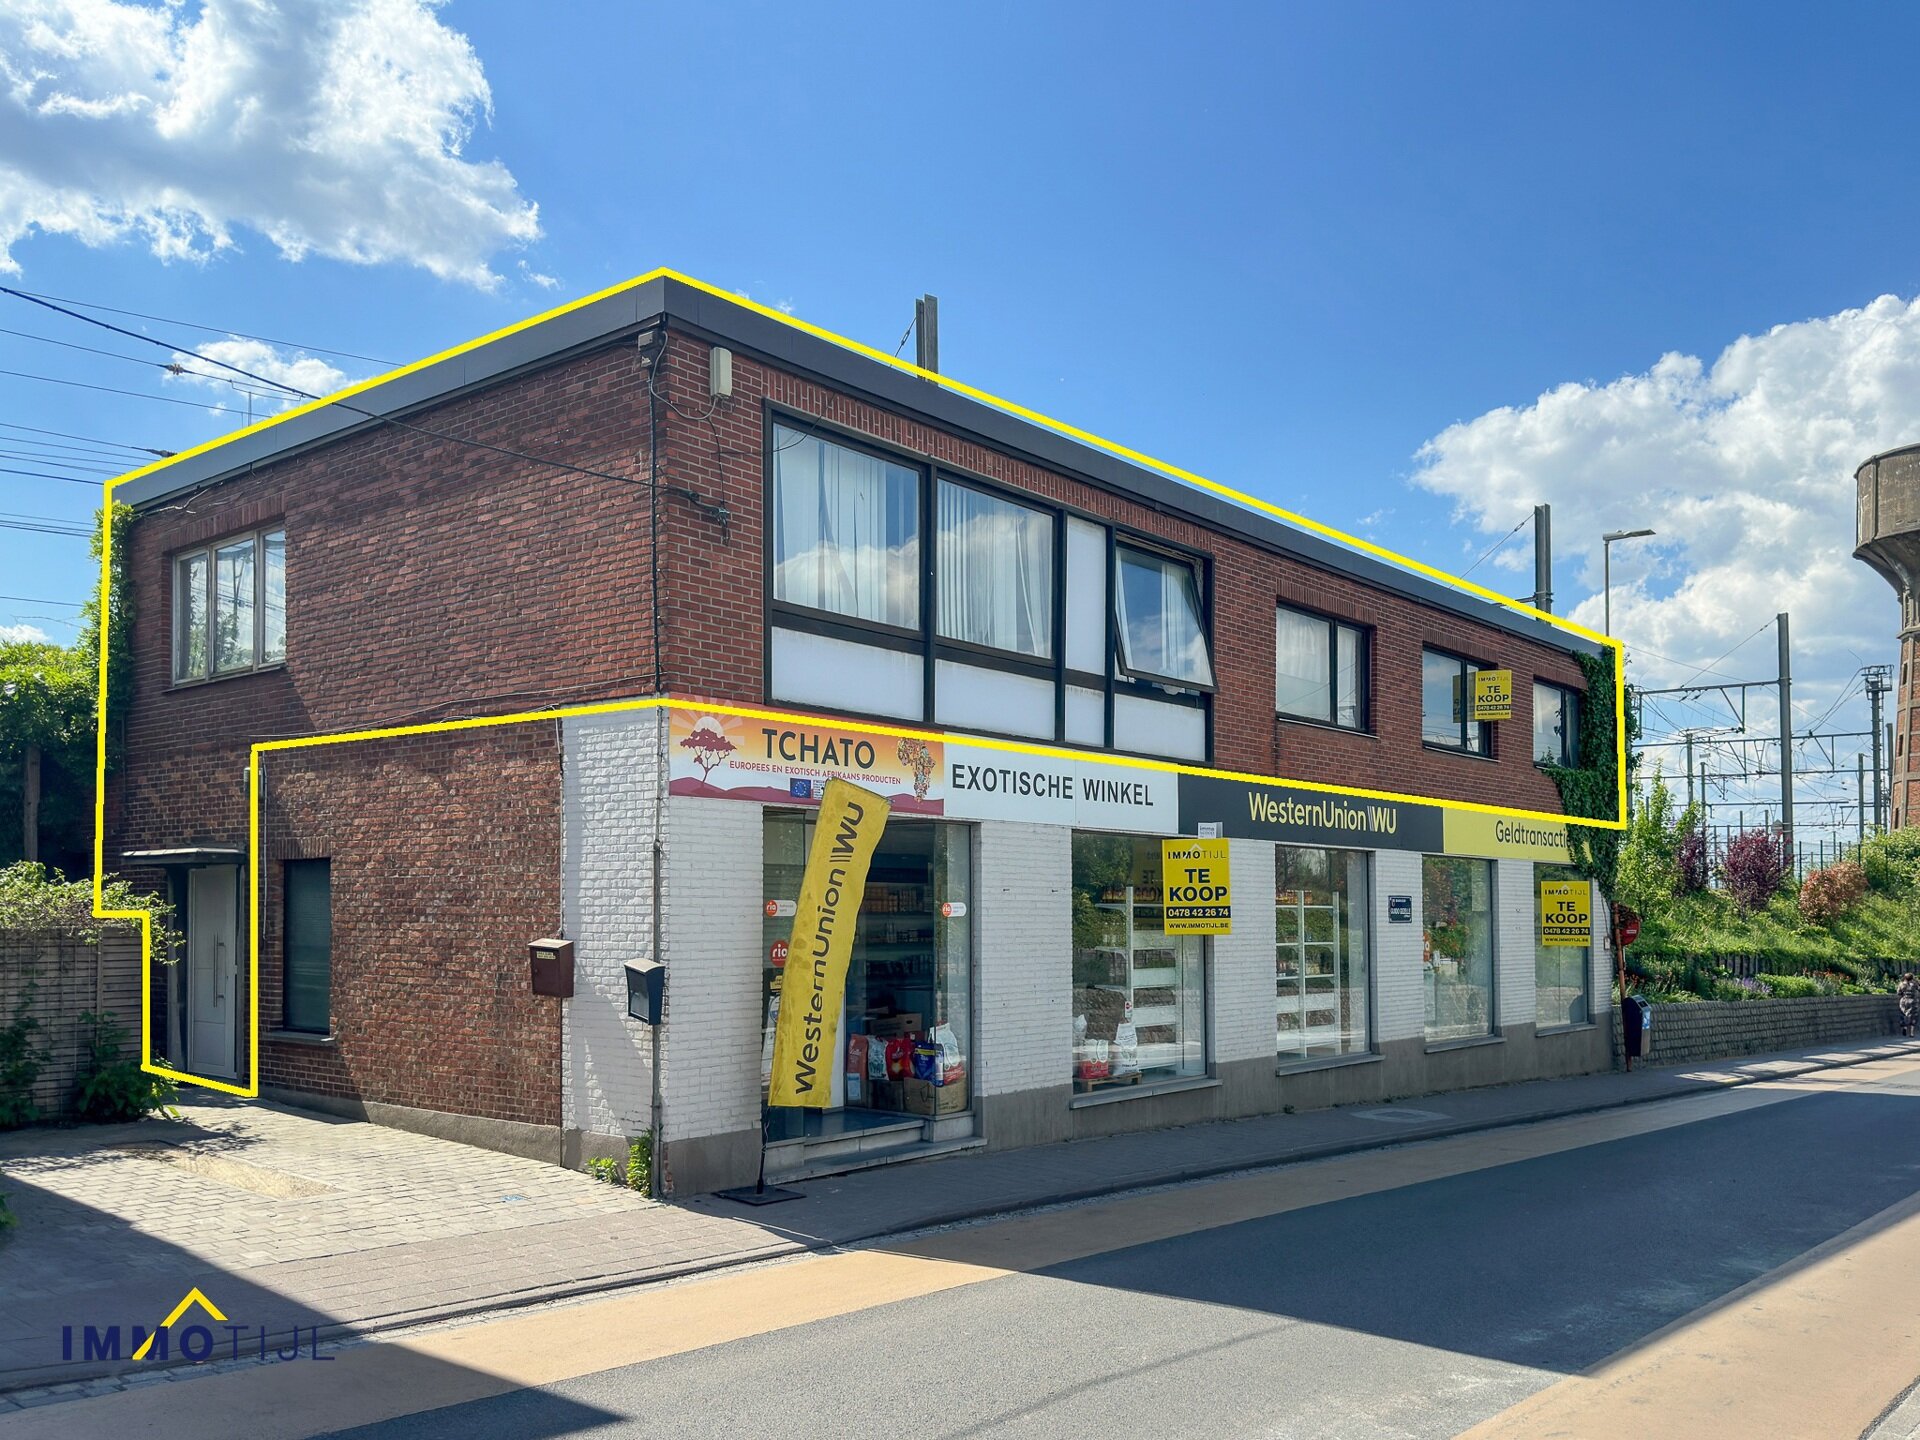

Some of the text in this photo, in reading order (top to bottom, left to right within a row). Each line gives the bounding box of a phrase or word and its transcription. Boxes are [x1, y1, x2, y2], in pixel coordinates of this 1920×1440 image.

[1487, 685, 1501, 693] TE
[1478, 694, 1510, 702] KOOP
[761, 728, 876, 770] TCHATO
[729, 760, 901, 785] EUROPEES EN EXOTISCH AFRIKAANS PRODUCTEN
[952, 763, 1154, 806] EXOTISCHE WINKEL
[1248, 791, 1367, 832] WesternUnion
[1167, 850, 1227, 860] IMMOTIJL
[1184, 868, 1211, 884] TE
[1169, 886, 1228, 902] KOOP
[1168, 908, 1191, 917] 0478
[1192, 908, 1204, 917] 42
[1205, 908, 1217, 917] 26
[1218, 908, 1229, 916] 74
[1557, 901, 1576, 911] TE
[1545, 913, 1588, 924] KOOP
